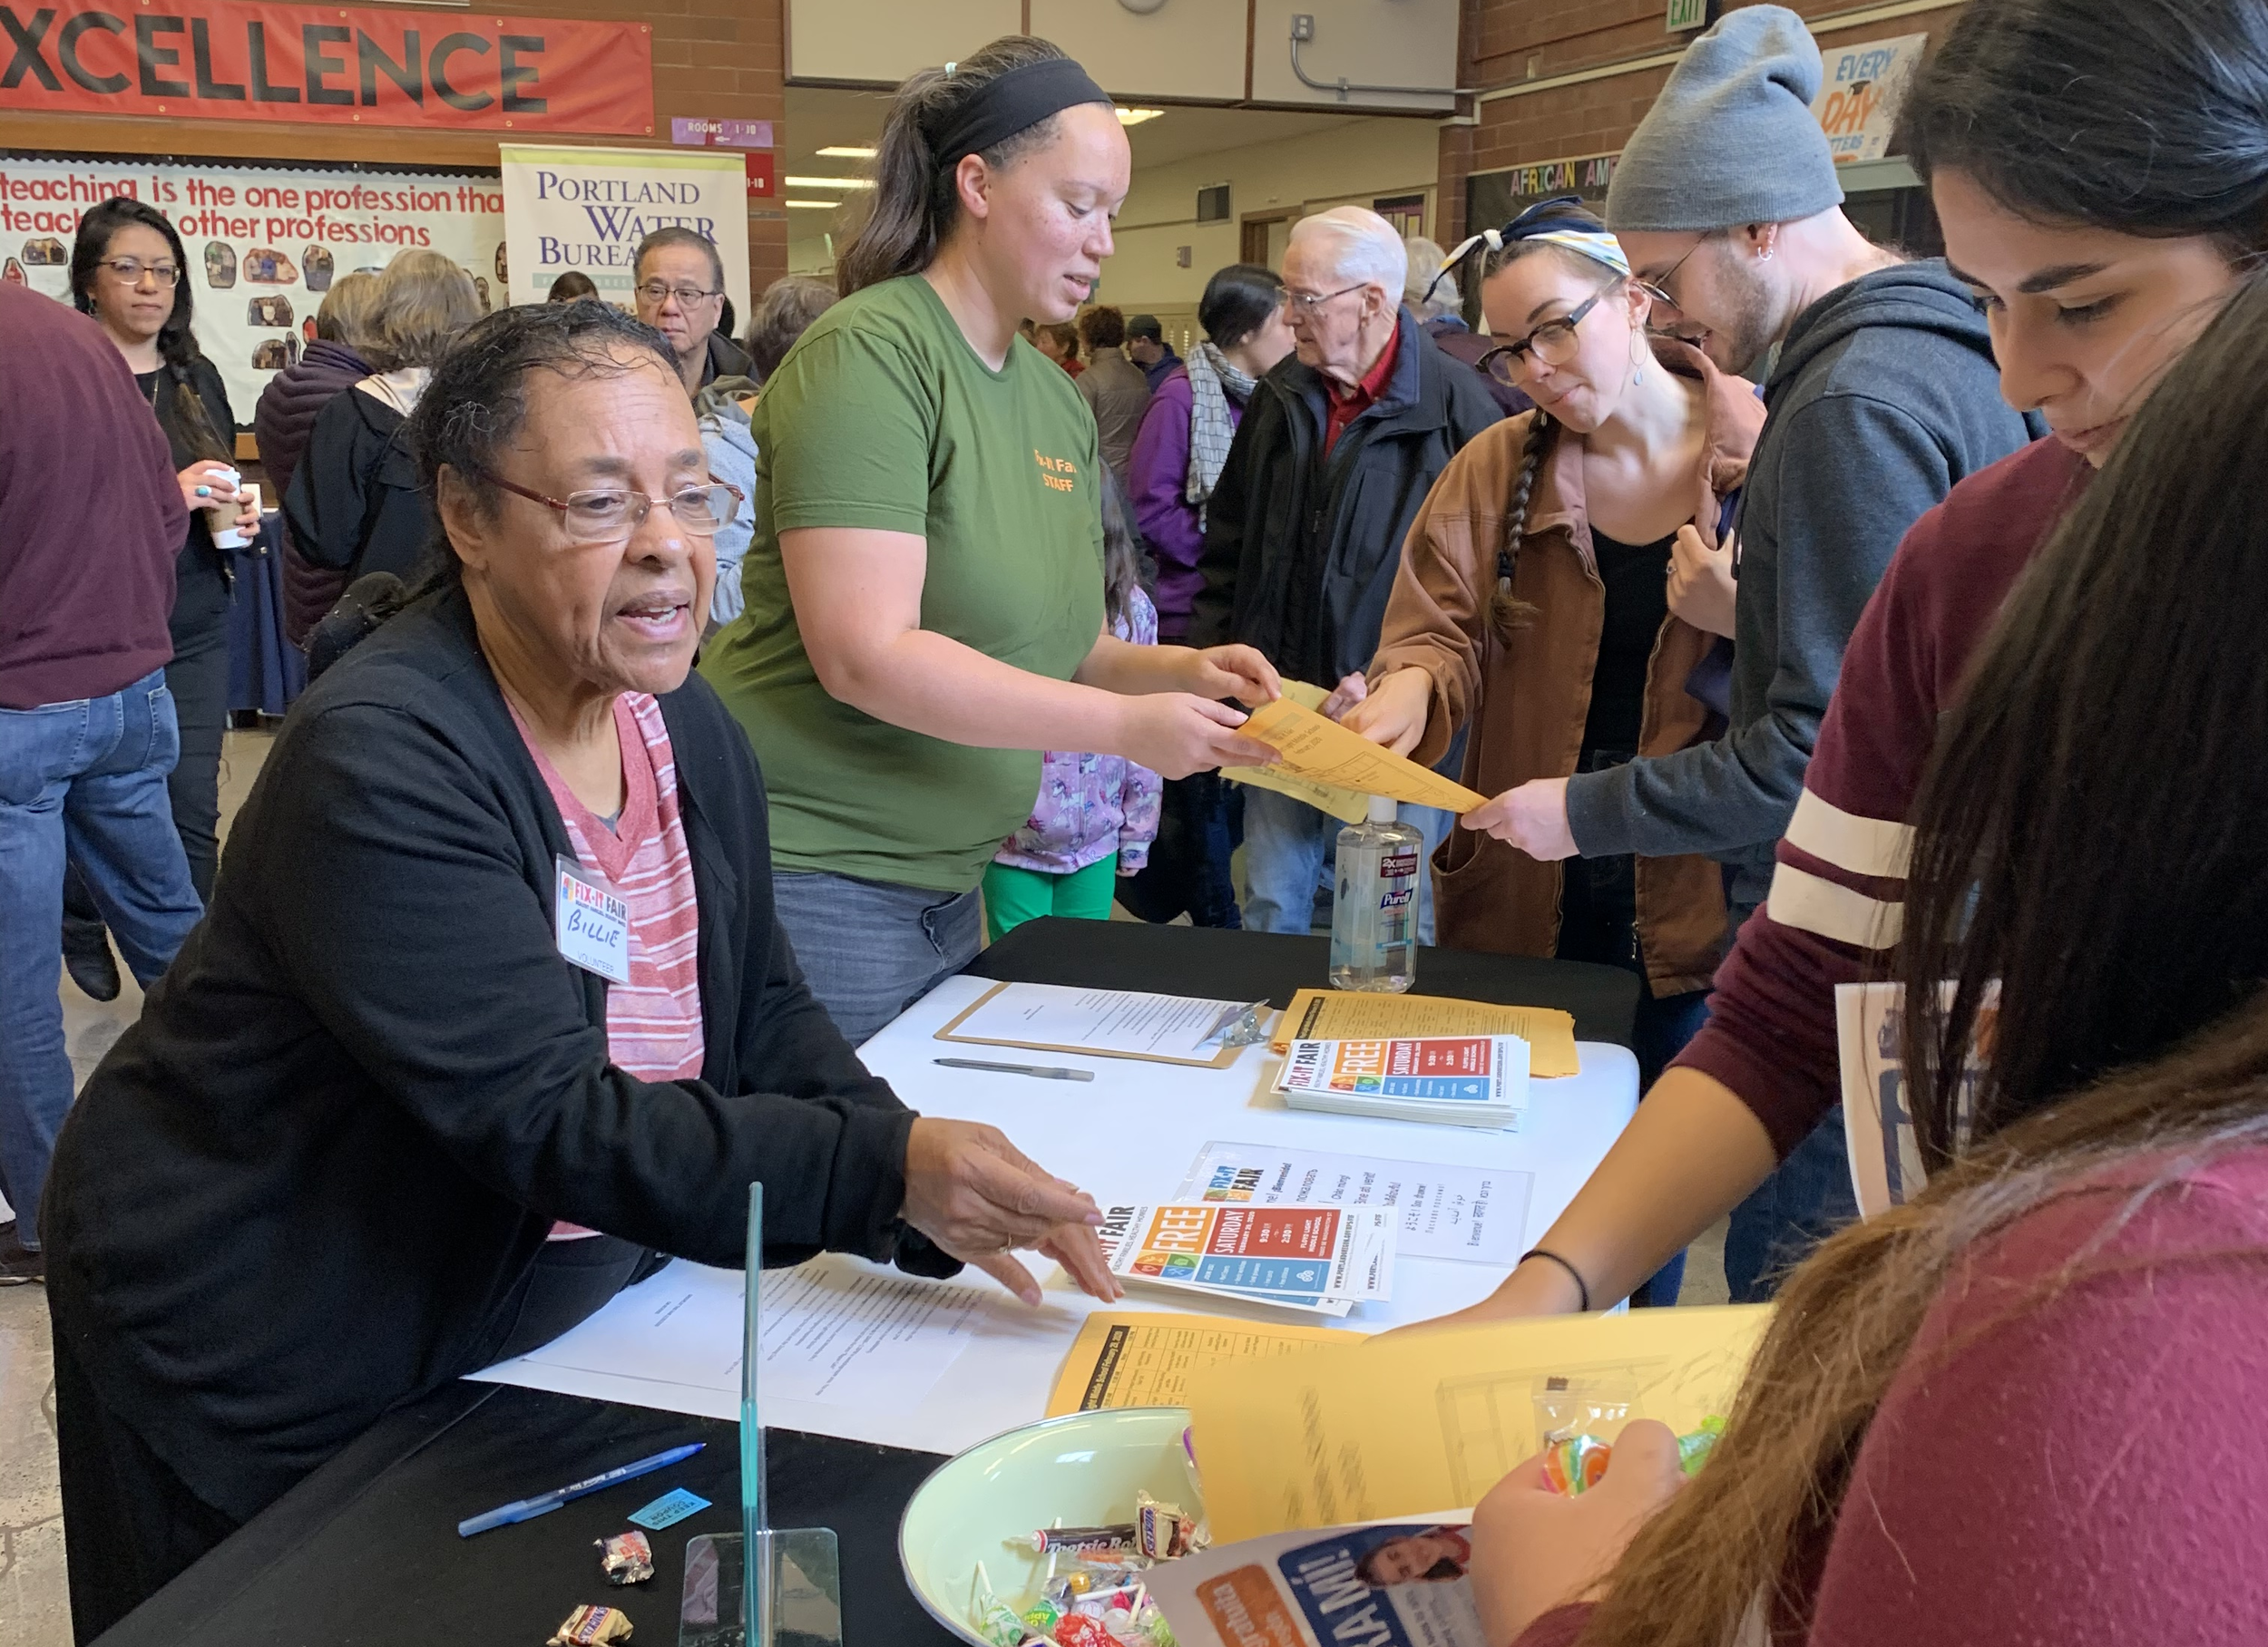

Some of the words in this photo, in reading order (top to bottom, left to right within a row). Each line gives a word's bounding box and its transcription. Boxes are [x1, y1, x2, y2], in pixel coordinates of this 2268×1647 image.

[1670, 0, 1699, 26] EXIT
[0, 6, 547, 112] XCELLENCE
[1835, 48, 1898, 82] EVERY
[1821, 85, 1884, 134] DAY
[687, 122, 723, 134] ROOMS
[536, 171, 700, 205] PORTLAND
[1510, 161, 1576, 197] AFRICAN
[1585, 156, 1619, 188] AME
[0, 171, 137, 203] teaching
[152, 175, 178, 202] is
[186, 178, 236, 208] the
[245, 187, 299, 209] one
[306, 184, 452, 217] profession
[456, 186, 504, 214] tha
[179, 210, 259, 238] other
[267, 216, 431, 247] professions
[539, 237, 636, 267] BUREA
[1042, 473, 1073, 492] STAFF
[574, 880, 604, 910] FIX-IT
[606, 894, 628, 921] FAIR
[567, 909, 621, 949] BILLIE
[577, 950, 615, 975] VOLUNTEER
[1295, 1042, 1321, 1065] FAIR
[1341, 1043, 1382, 1074] FREE
[1393, 1042, 1413, 1075] SATURDAY
[1287, 1066, 1315, 1087] FIX-IT
[1208, 1165, 1237, 1189] FIX-IT
[1231, 1168, 1264, 1191] FAIR
[1099, 1206, 1136, 1237] FAIR
[1151, 1210, 1207, 1252] FREE
[1214, 1210, 1245, 1253] SATURDAY
[1259, 1229, 1271, 1243] 9:30
[1281, 1229, 1292, 1243] 2:30
[1303, 1219, 1313, 1233] LIGHT
[1310, 1216, 1322, 1234] SCHOOL
[1237, 1231, 1250, 1253] FEBRUARY
[1048, 1539, 1108, 1554] Tootsie
[1108, 1536, 1136, 1550] Rol
[1143, 1507, 1156, 1552] NICKERS
[1291, 1548, 1372, 1614] MÍ!
